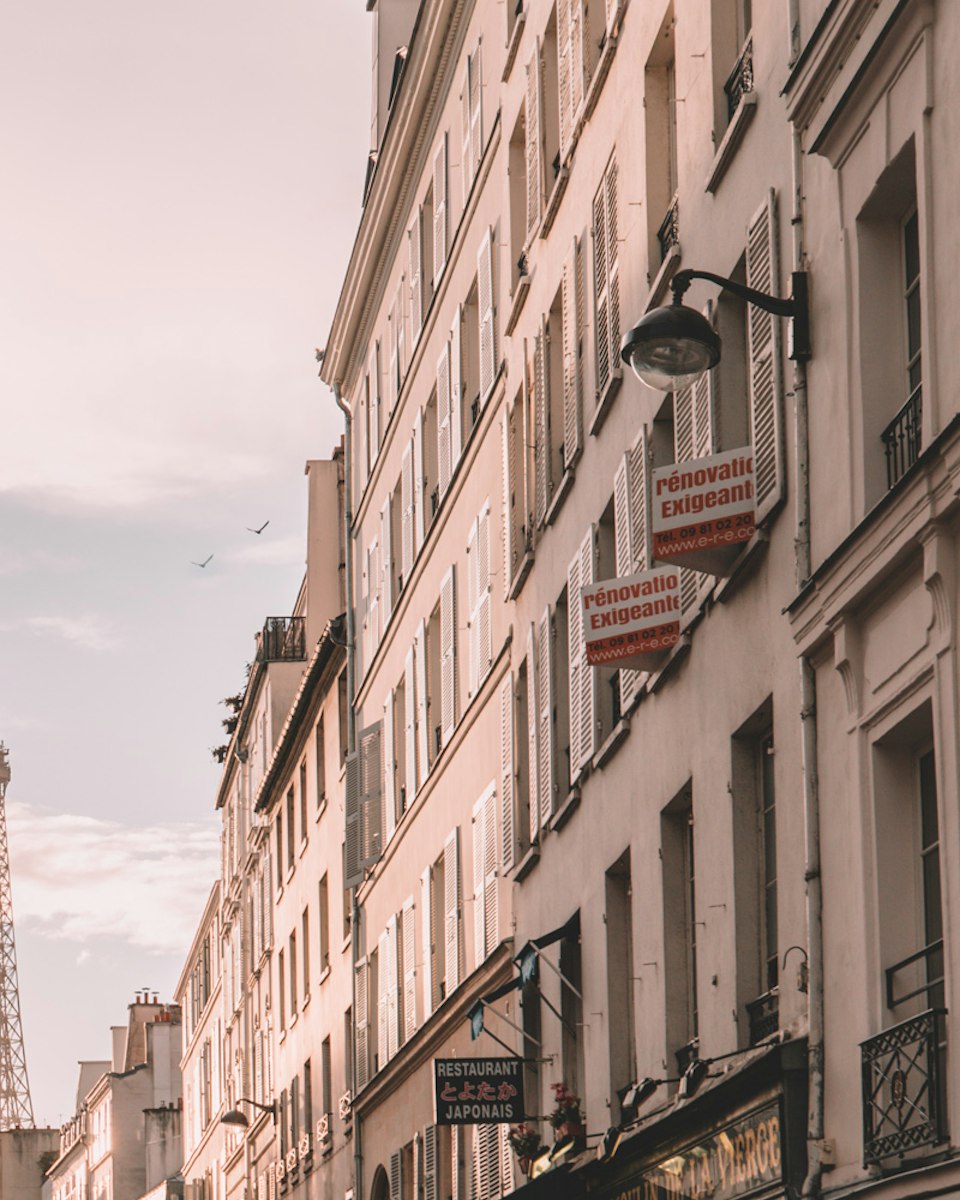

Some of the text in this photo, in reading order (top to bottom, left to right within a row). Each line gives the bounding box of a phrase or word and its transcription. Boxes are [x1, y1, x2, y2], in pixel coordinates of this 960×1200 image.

[662, 480, 754, 519] Exigeant
[680, 527, 696, 538] 09
[700, 523, 712, 534] 81
[716, 519, 731, 530] 02
[735, 514, 752, 526] 20
[609, 638, 624, 647] 09
[628, 633, 638, 643] 81
[642, 630, 657, 639] 02
[660, 625, 674, 636] 20
[437, 1061, 519, 1077] RESTAURANT
[440, 1081, 518, 1102] とよたか
[445, 1103, 514, 1119] JAPONAIS
